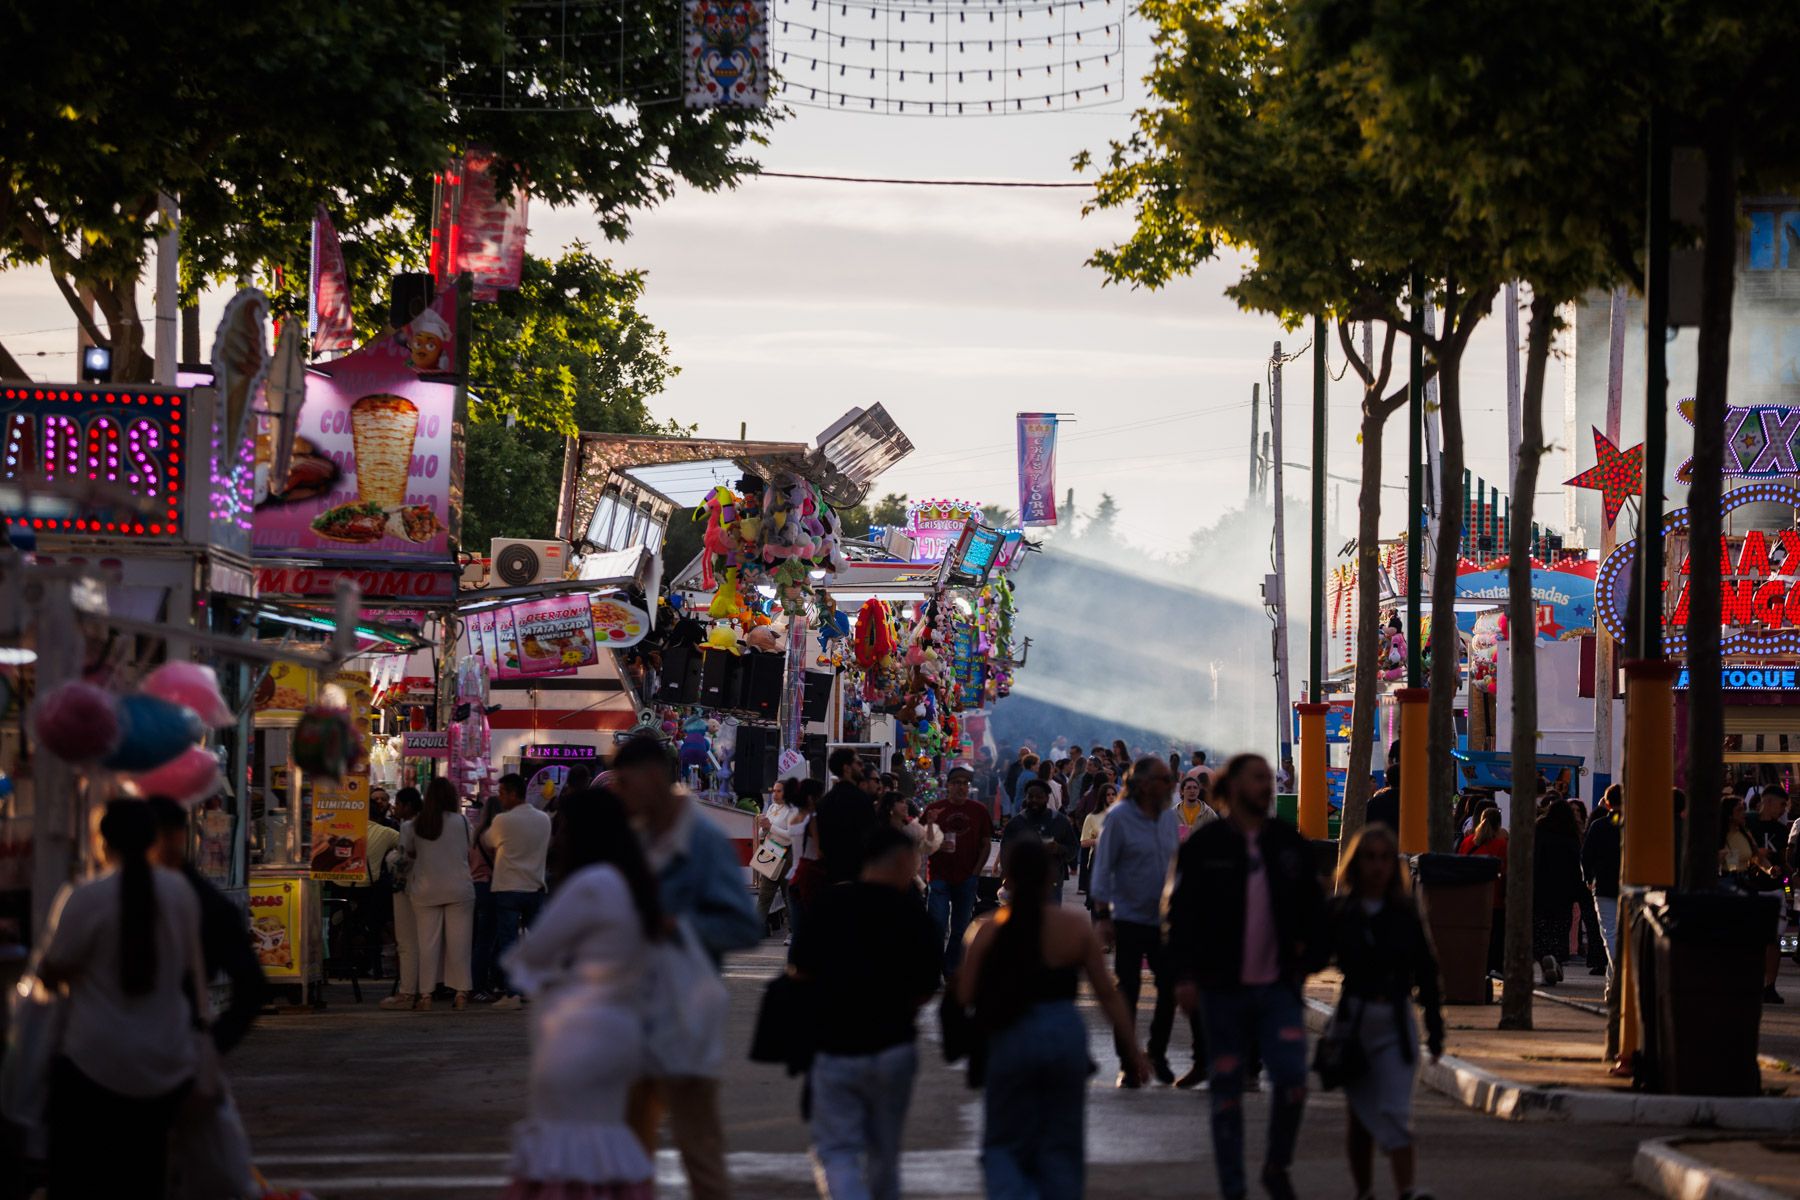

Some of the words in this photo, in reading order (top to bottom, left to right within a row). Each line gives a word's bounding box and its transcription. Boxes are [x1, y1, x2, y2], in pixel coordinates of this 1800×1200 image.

[1531, 584, 1571, 606] sadas
[520, 625, 555, 637] PATATA
[557, 620, 590, 632] ASADA
[1721, 670, 1796, 688] TOQUE
[407, 736, 449, 748] TAQUILL
[527, 747, 560, 758] PINK
[563, 747, 594, 758] DATE
[316, 800, 366, 810] ILIMITADO
